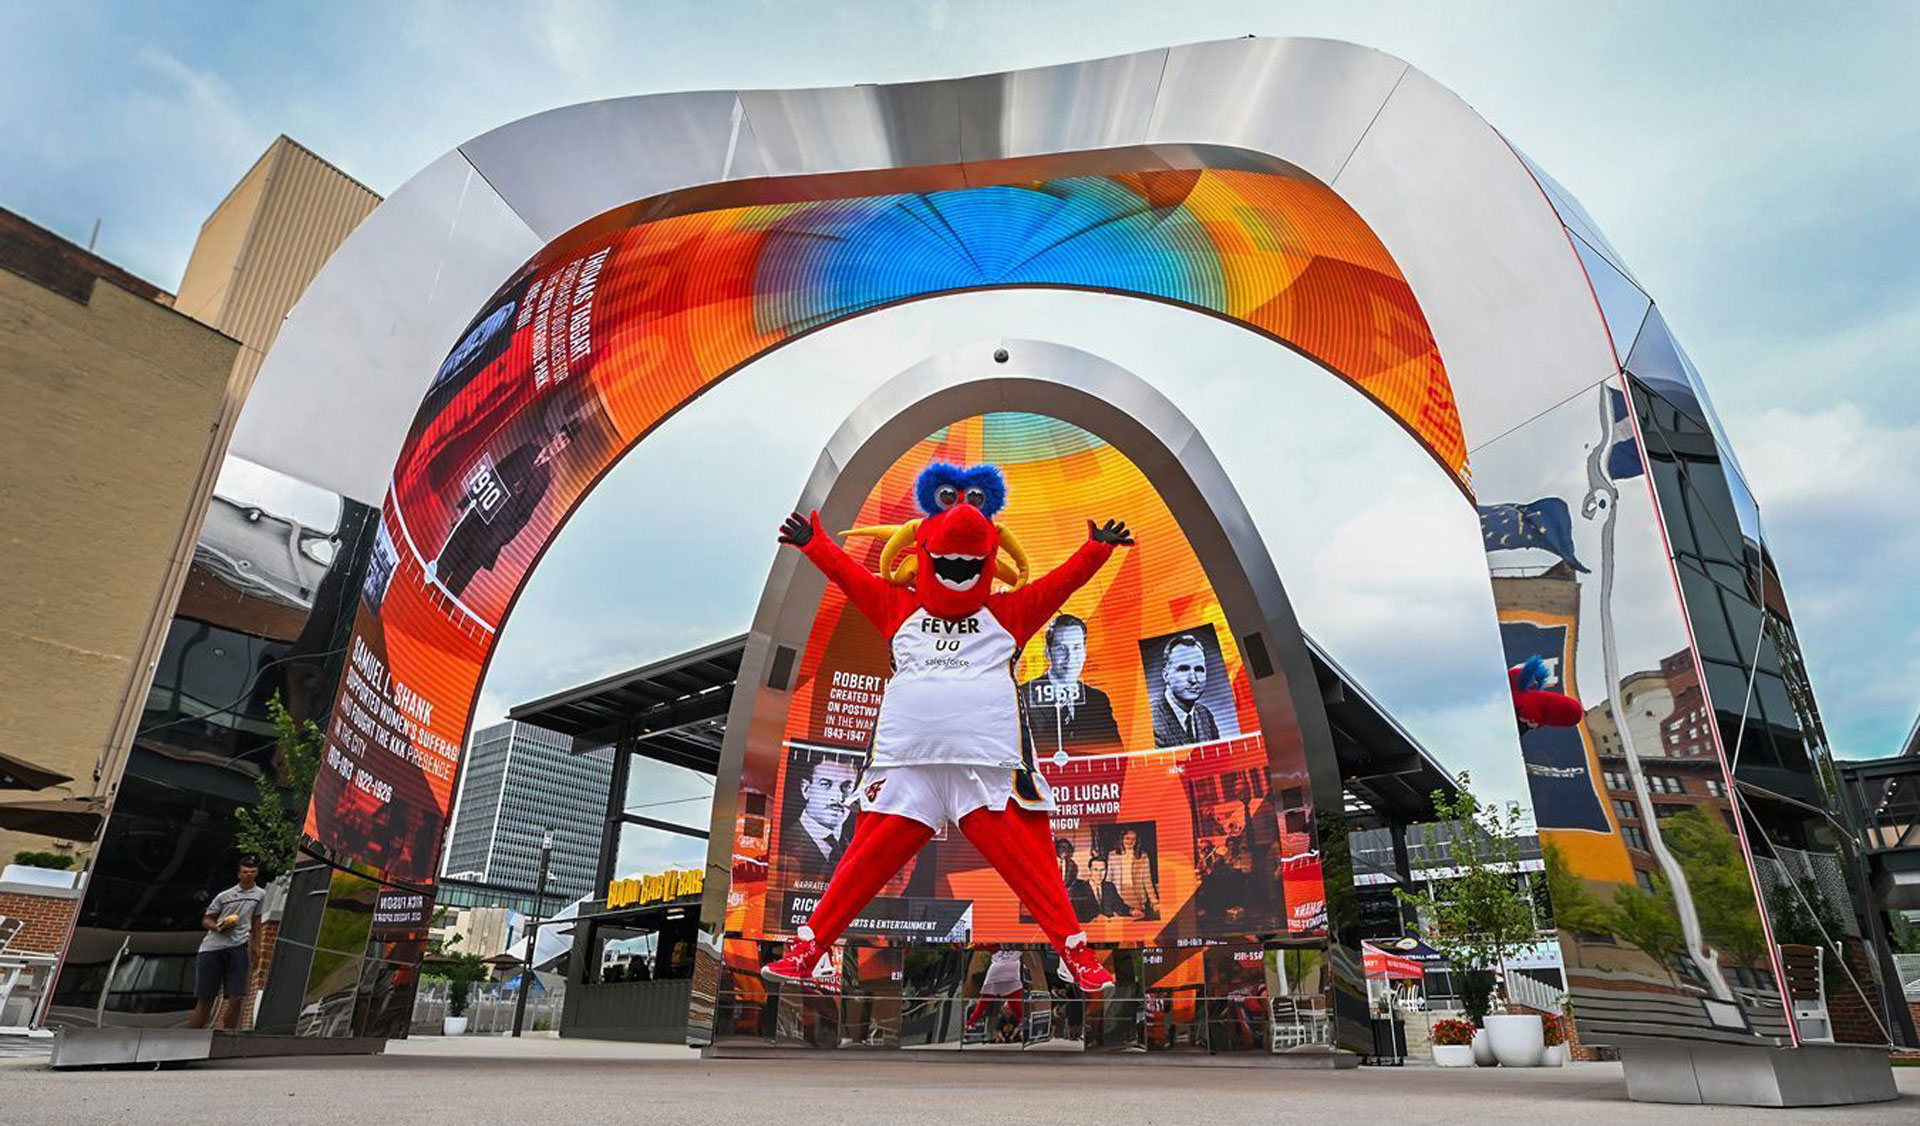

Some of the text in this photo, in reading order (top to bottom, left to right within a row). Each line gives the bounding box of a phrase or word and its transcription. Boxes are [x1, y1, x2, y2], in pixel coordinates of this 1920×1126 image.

[570, 247, 611, 363] THOMAS TAGGART
[532, 309, 550, 366] RIVERSIDE
[551, 333, 567, 367] ACRES
[534, 359, 550, 391] PARK
[552, 361, 569, 386] FOR
[470, 465, 500, 511] 1910
[921, 618, 980, 634] FEVER
[925, 657, 970, 667] salesforce
[352, 635, 434, 727] SAMUEL L. SHANK
[833, 671, 881, 691] ROBERT
[346, 665, 381, 715] SUPPORTED
[380, 701, 418, 740] WOMEN'S
[830, 688, 883, 705] CREATED TH
[827, 702, 878, 717] ON POSTWA
[826, 716, 835, 725] IN
[838, 716, 854, 728] THE
[341, 723, 354, 748] THE
[350, 734, 368, 759] CITY
[351, 703, 377, 738] FOUGHT
[375, 724, 390, 749] THE
[389, 735, 407, 759] KKK
[406, 745, 453, 781] PRESENCE
[824, 728, 866, 742] 1943-1947
[355, 769, 393, 803] 1922-1926
[1074, 784, 1119, 801] LUGAR
[1056, 802, 1121, 816] FIRST MAYOR
[1049, 818, 1080, 830] NIGOV
[607, 878, 640, 909] BOOM
[677, 869, 703, 896] BAR
[792, 897, 821, 912] RICK
[869, 919, 876, 928] &
[876, 919, 937, 930] ENTERTAINMENT
